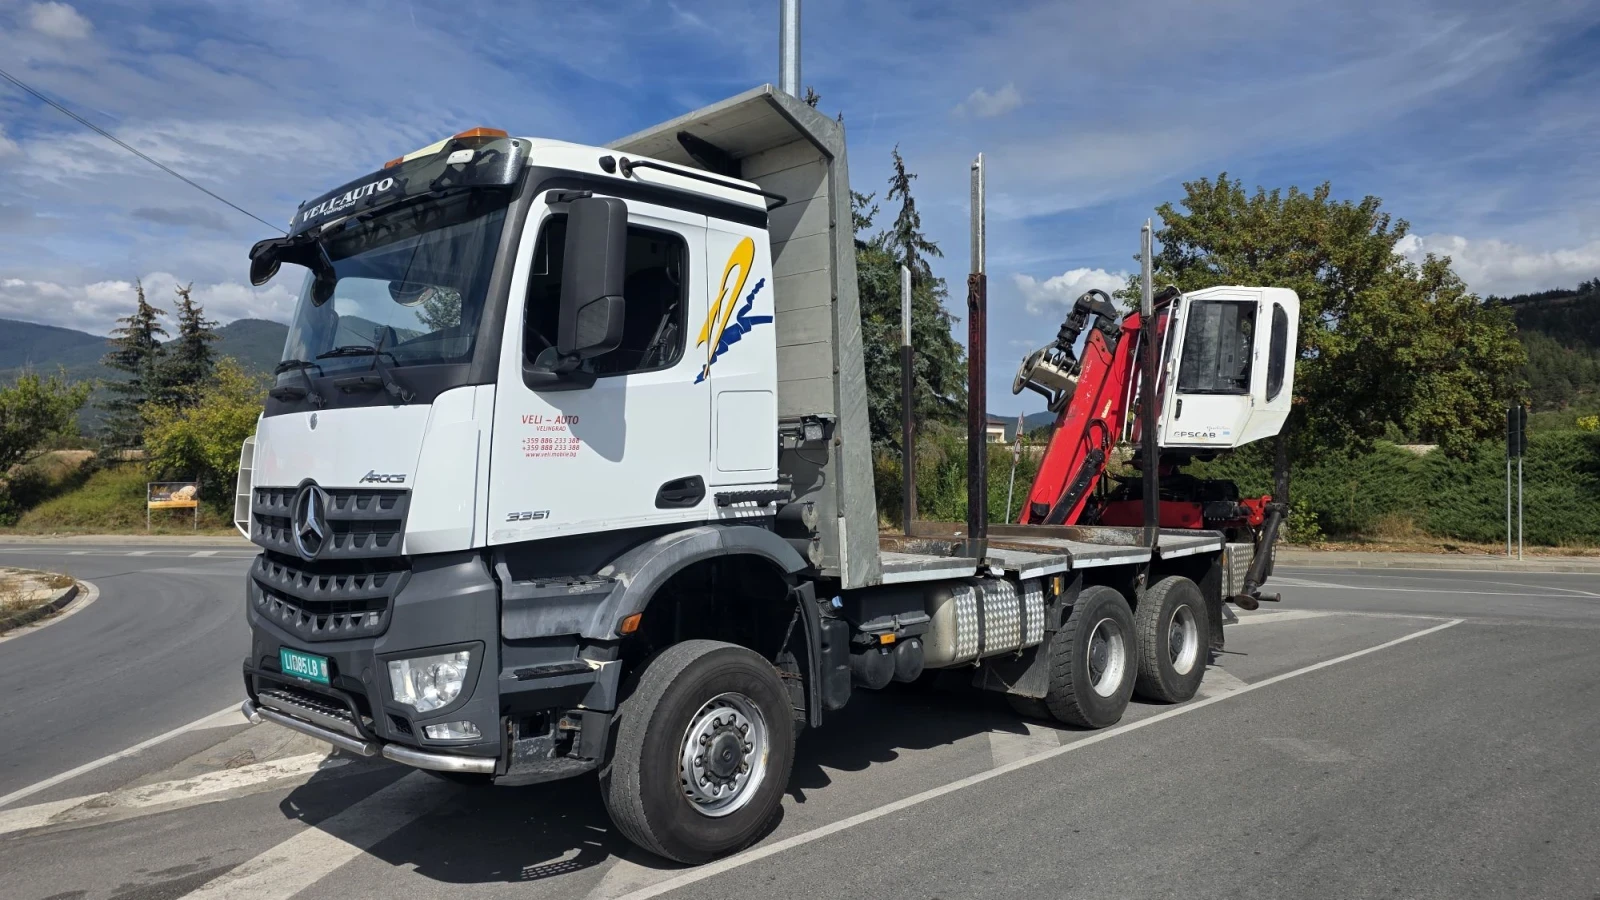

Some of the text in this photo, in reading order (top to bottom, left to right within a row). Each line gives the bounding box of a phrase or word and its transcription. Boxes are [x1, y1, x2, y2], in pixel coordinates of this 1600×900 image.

[303, 177, 394, 222] VELI-AUTO
[522, 415, 543, 425] VELI
[554, 415, 579, 425] AUTO
[505, 510, 551, 522] 3351
